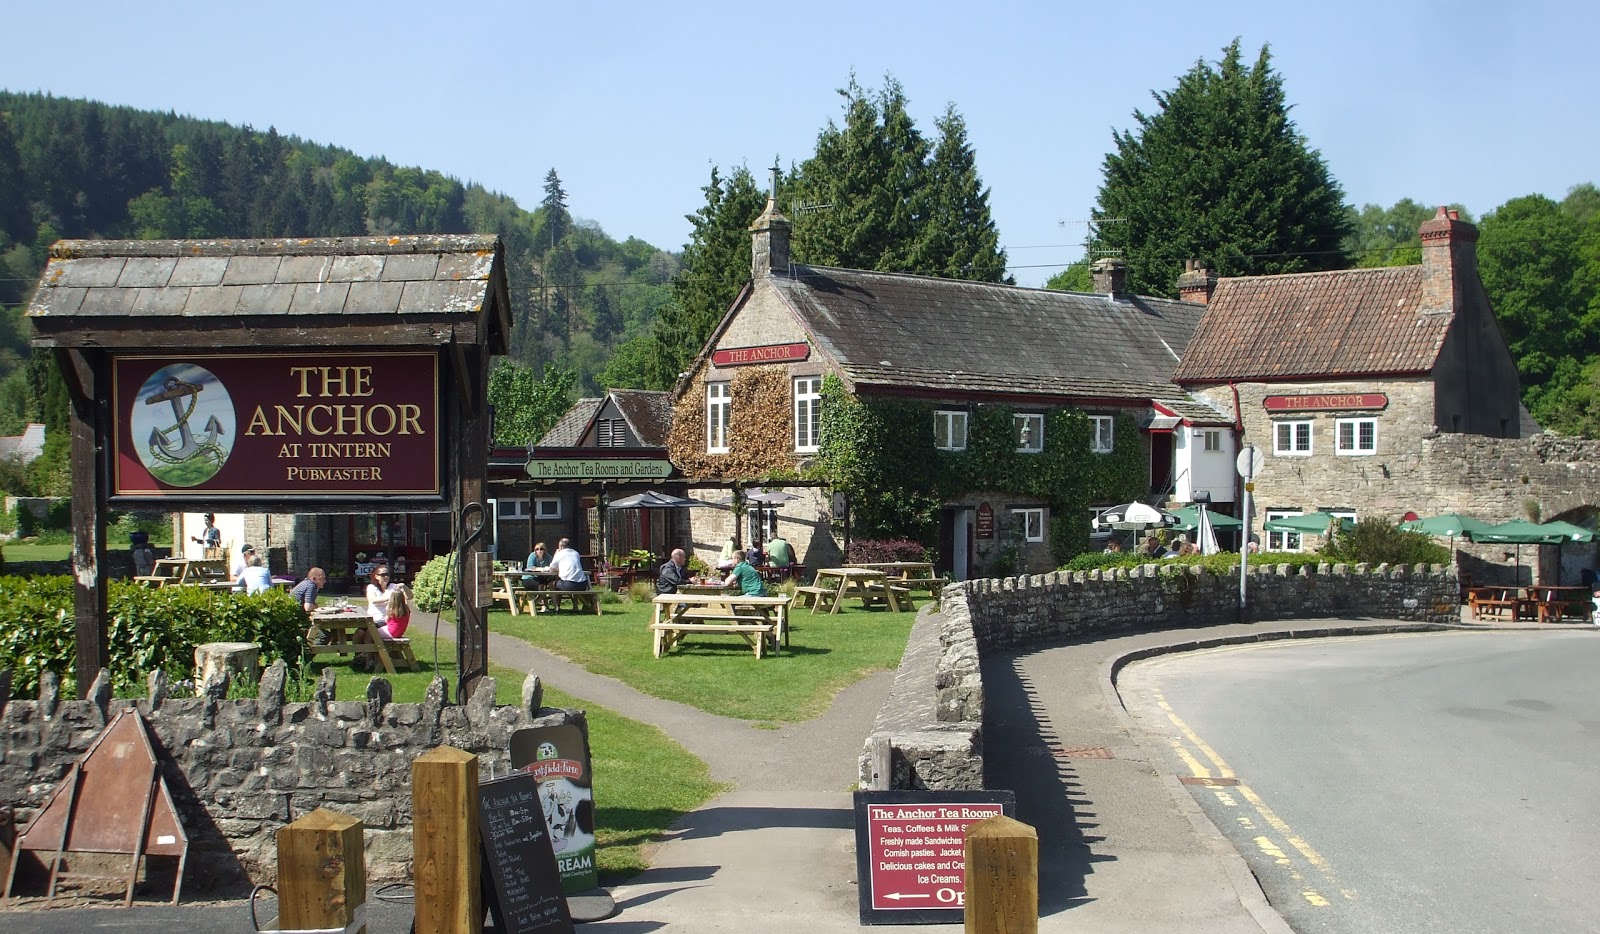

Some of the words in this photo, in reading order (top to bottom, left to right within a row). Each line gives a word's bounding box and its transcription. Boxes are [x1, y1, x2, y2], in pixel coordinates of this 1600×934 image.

[729, 351, 748, 362] THE
[751, 346, 791, 360] ANCHOR
[290, 366, 375, 397] THE
[1285, 397, 1310, 408] THE
[1312, 395, 1364, 408] ANCHOR
[244, 404, 426, 436] ANCHOR
[278, 443, 303, 458] AT
[308, 442, 392, 458] TINTERN
[537, 463, 551, 475] The
[553, 463, 579, 475] Anchor
[580, 463, 594, 475] Tea
[595, 463, 619, 475] Rooms
[620, 463, 633, 475] and
[634, 463, 663, 475] Gardens
[872, 808, 894, 819] The
[896, 808, 936, 819] Anchor
[938, 808, 959, 818] Tea
[961, 808, 998, 818] Rooms
[882, 825, 904, 834] Teas,
[905, 824, 935, 833] Coffees
[936, 825, 943, 833] &
[944, 824, 960, 832] Milk
[880, 837, 904, 848] Freshly
[905, 836, 923, 845] made
[924, 836, 962, 845] Sandwiches
[884, 849, 910, 858] Cornish
[911, 848, 936, 859] pasties.
[940, 848, 962, 857] Jacket
[558, 855, 592, 873] REAM
[880, 862, 913, 871] Delicious
[914, 861, 935, 870] cakes
[937, 861, 951, 870] and
[952, 860, 965, 870] Cre
[917, 874, 929, 884] Ice
[931, 874, 962, 884] Creams.
[936, 887, 965, 906] Op
